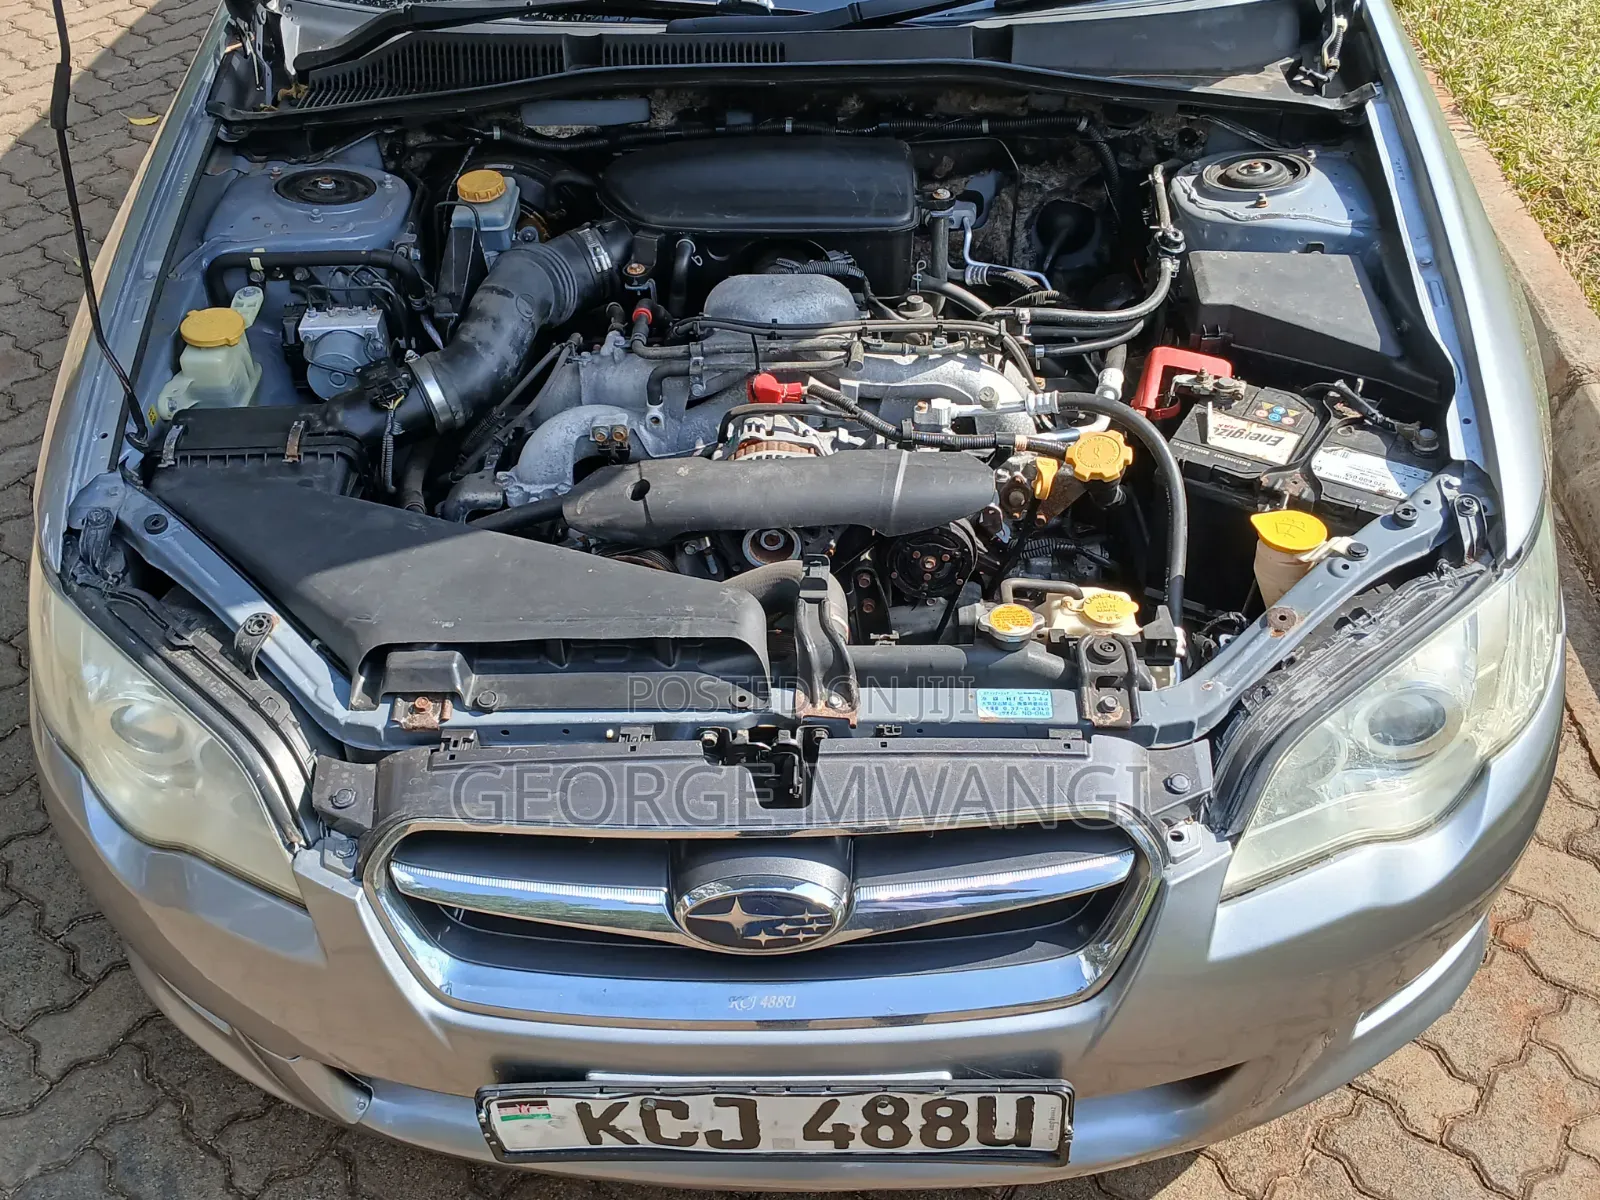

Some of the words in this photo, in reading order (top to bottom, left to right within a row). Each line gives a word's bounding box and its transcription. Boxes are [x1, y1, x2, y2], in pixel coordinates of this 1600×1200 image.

[728, 995, 757, 1011] KCJ
[760, 995, 797, 1009] 488U
[575, 1096, 761, 1151] KCJ
[802, 1095, 1036, 1151] 488U
